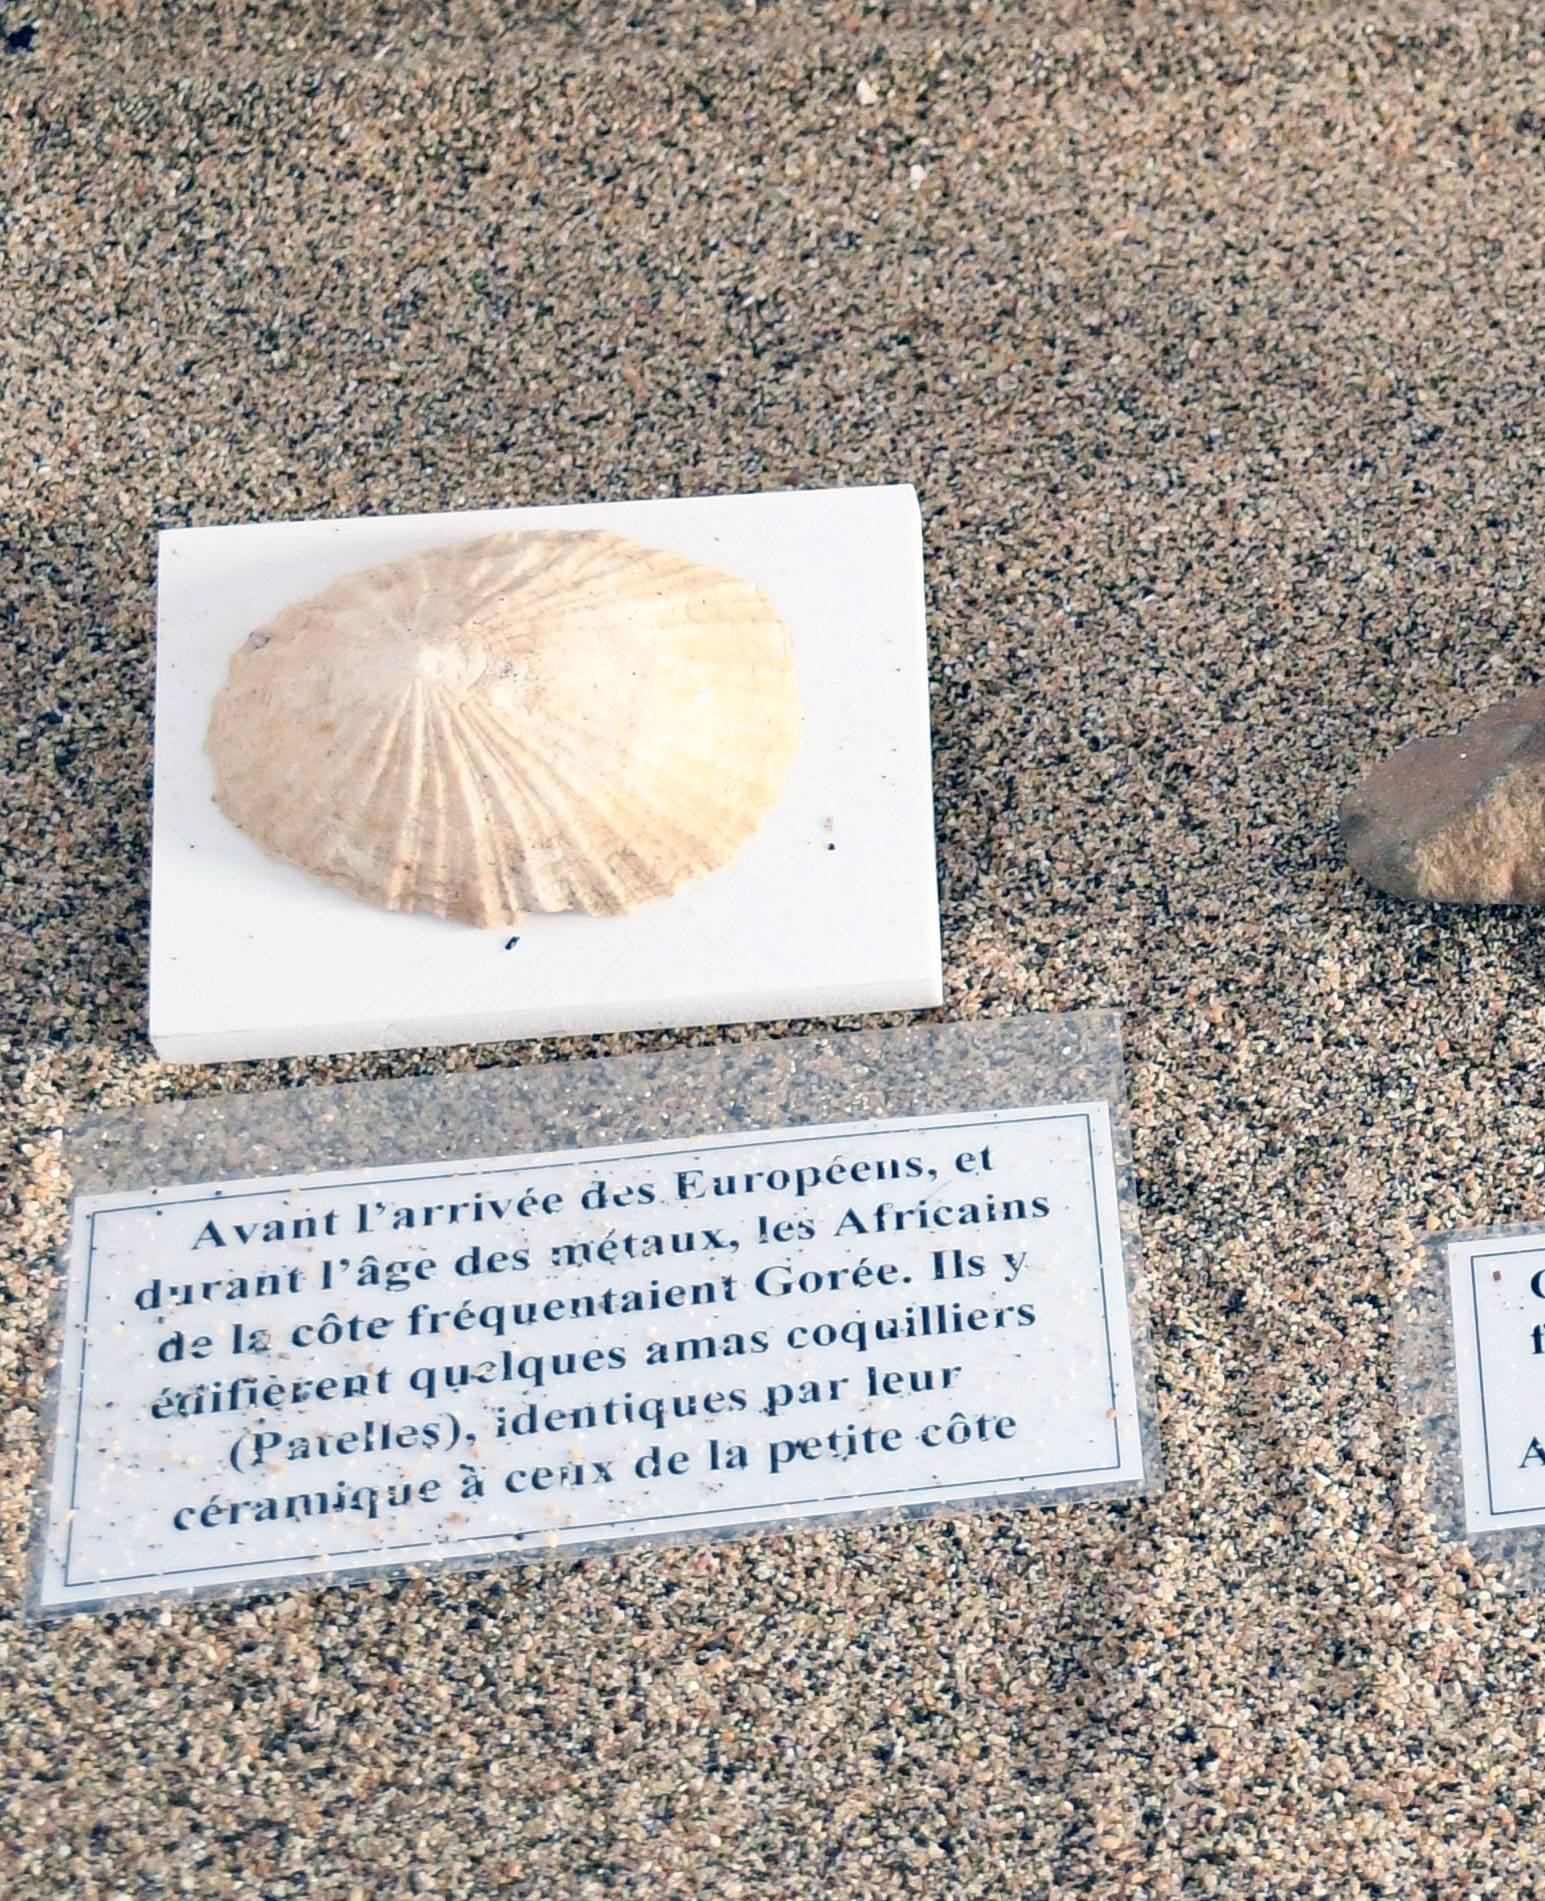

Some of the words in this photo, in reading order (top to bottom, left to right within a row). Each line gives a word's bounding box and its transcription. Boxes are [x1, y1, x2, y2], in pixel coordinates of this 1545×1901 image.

[135, 1268, 303, 1311] durant
[455, 1247, 529, 1276] des
[552, 1229, 740, 1267] métaux,
[759, 1216, 815, 1242] les
[835, 1194, 1051, 1237] Africains
[191, 1209, 339, 1250] Avant
[582, 1181, 655, 1209] des
[678, 1156, 938, 1196] Européens,
[956, 1147, 991, 1172] et
[158, 1331, 212, 1362] de
[233, 1324, 269, 1354] la
[292, 1313, 393, 1347] côte
[408, 1276, 735, 1336] fréquentaient
[756, 1257, 912, 1297] Gorée.
[934, 1250, 984, 1280] Ils
[1004, 1251, 1027, 1282] y
[410, 1344, 628, 1399] quelques
[647, 1328, 768, 1366] amas
[788, 1301, 1036, 1352] coquilliers
[174, 1480, 440, 1530] céramique
[460, 1464, 484, 1499] à
[506, 1463, 612, 1493] ceux
[635, 1447, 689, 1478] de
[710, 1440, 747, 1470] la
[770, 1424, 902, 1473] petite
[921, 1413, 1017, 1447] côte
[229, 1413, 476, 1473] (Patelles),
[497, 1391, 746, 1437] identiques
[766, 1377, 848, 1416] par
[868, 1365, 962, 1397] leur
